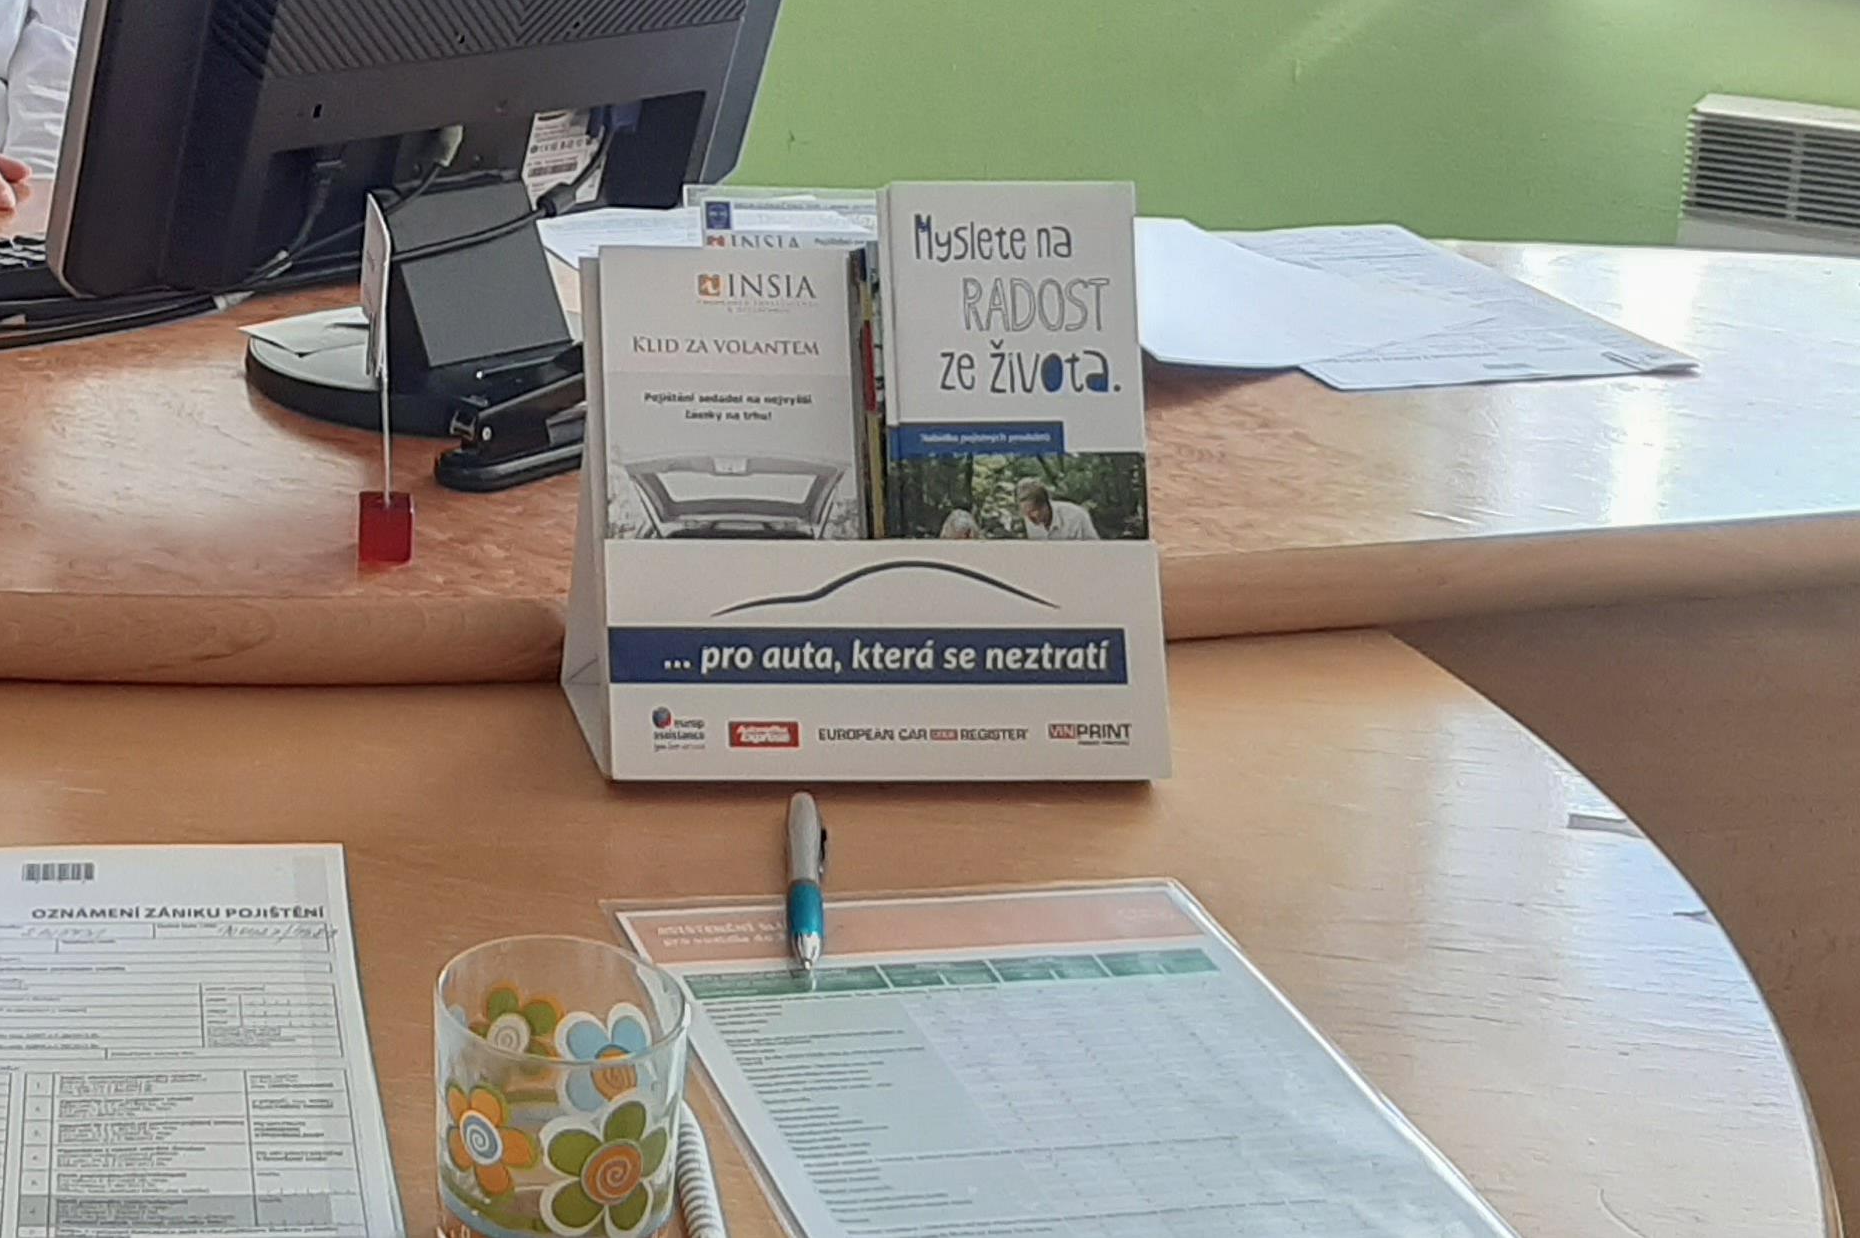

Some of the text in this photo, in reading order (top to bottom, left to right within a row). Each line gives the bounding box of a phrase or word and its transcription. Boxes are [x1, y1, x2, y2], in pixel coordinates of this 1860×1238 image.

[914, 213, 1072, 262] Myslete na
[728, 273, 817, 299] INSIA
[962, 277, 1110, 332] RADOST
[632, 335, 819, 355] KLID ZA VOLANTEM
[940, 339, 1121, 393] ze života.
[701, 644, 753, 674] pro
[762, 642, 842, 674] auta,
[852, 639, 935, 670] která
[943, 647, 976, 670] se
[985, 639, 1111, 670] neztratí
[818, 728, 894, 741] EUROPEAN
[898, 728, 928, 741] CAR
[960, 728, 1028, 741] REGISTER
[32, 905, 324, 919] OZNÁMENÍ ZÁNIKU POJIŠTĚNÍ
